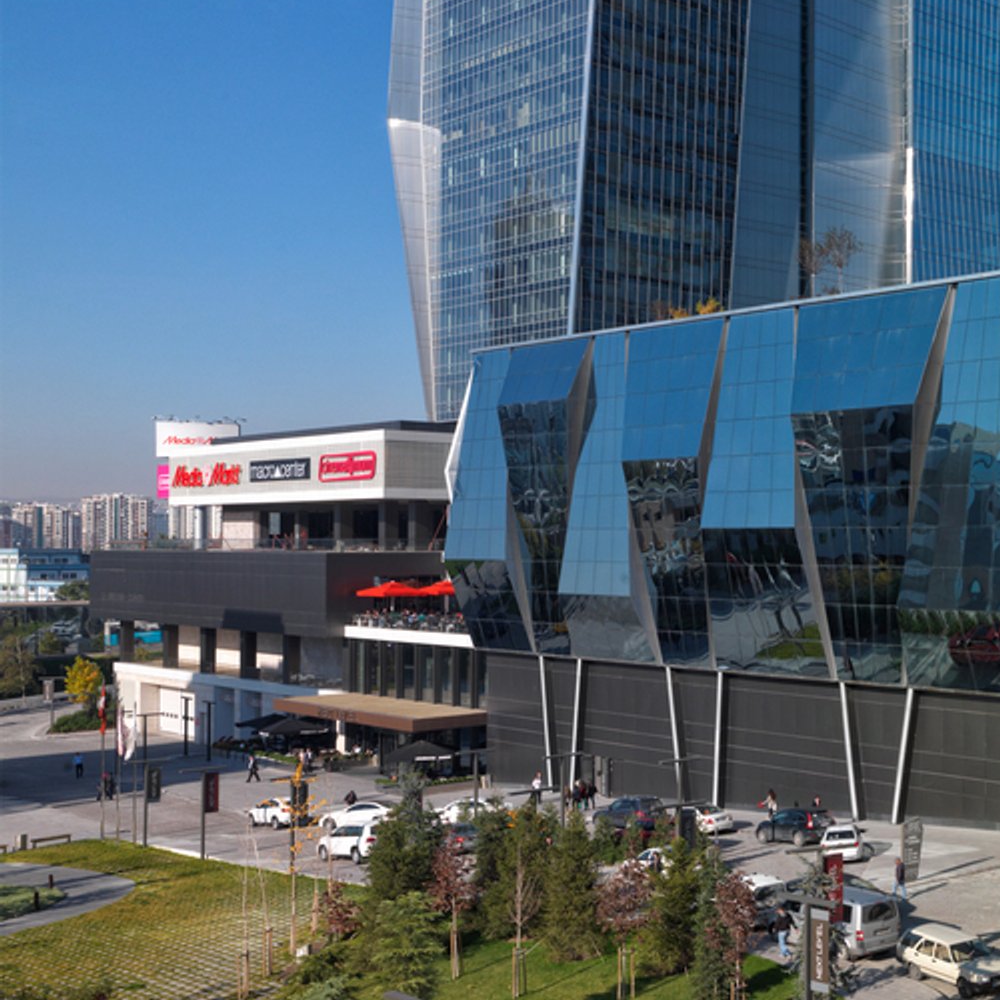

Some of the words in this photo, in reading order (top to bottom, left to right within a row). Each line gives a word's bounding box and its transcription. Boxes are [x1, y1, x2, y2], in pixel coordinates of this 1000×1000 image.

[172, 465, 203, 488] Media
[208, 462, 241, 486] Markt
[816, 922, 824, 955] LEVEL
[816, 955, 824, 980] NEXT
